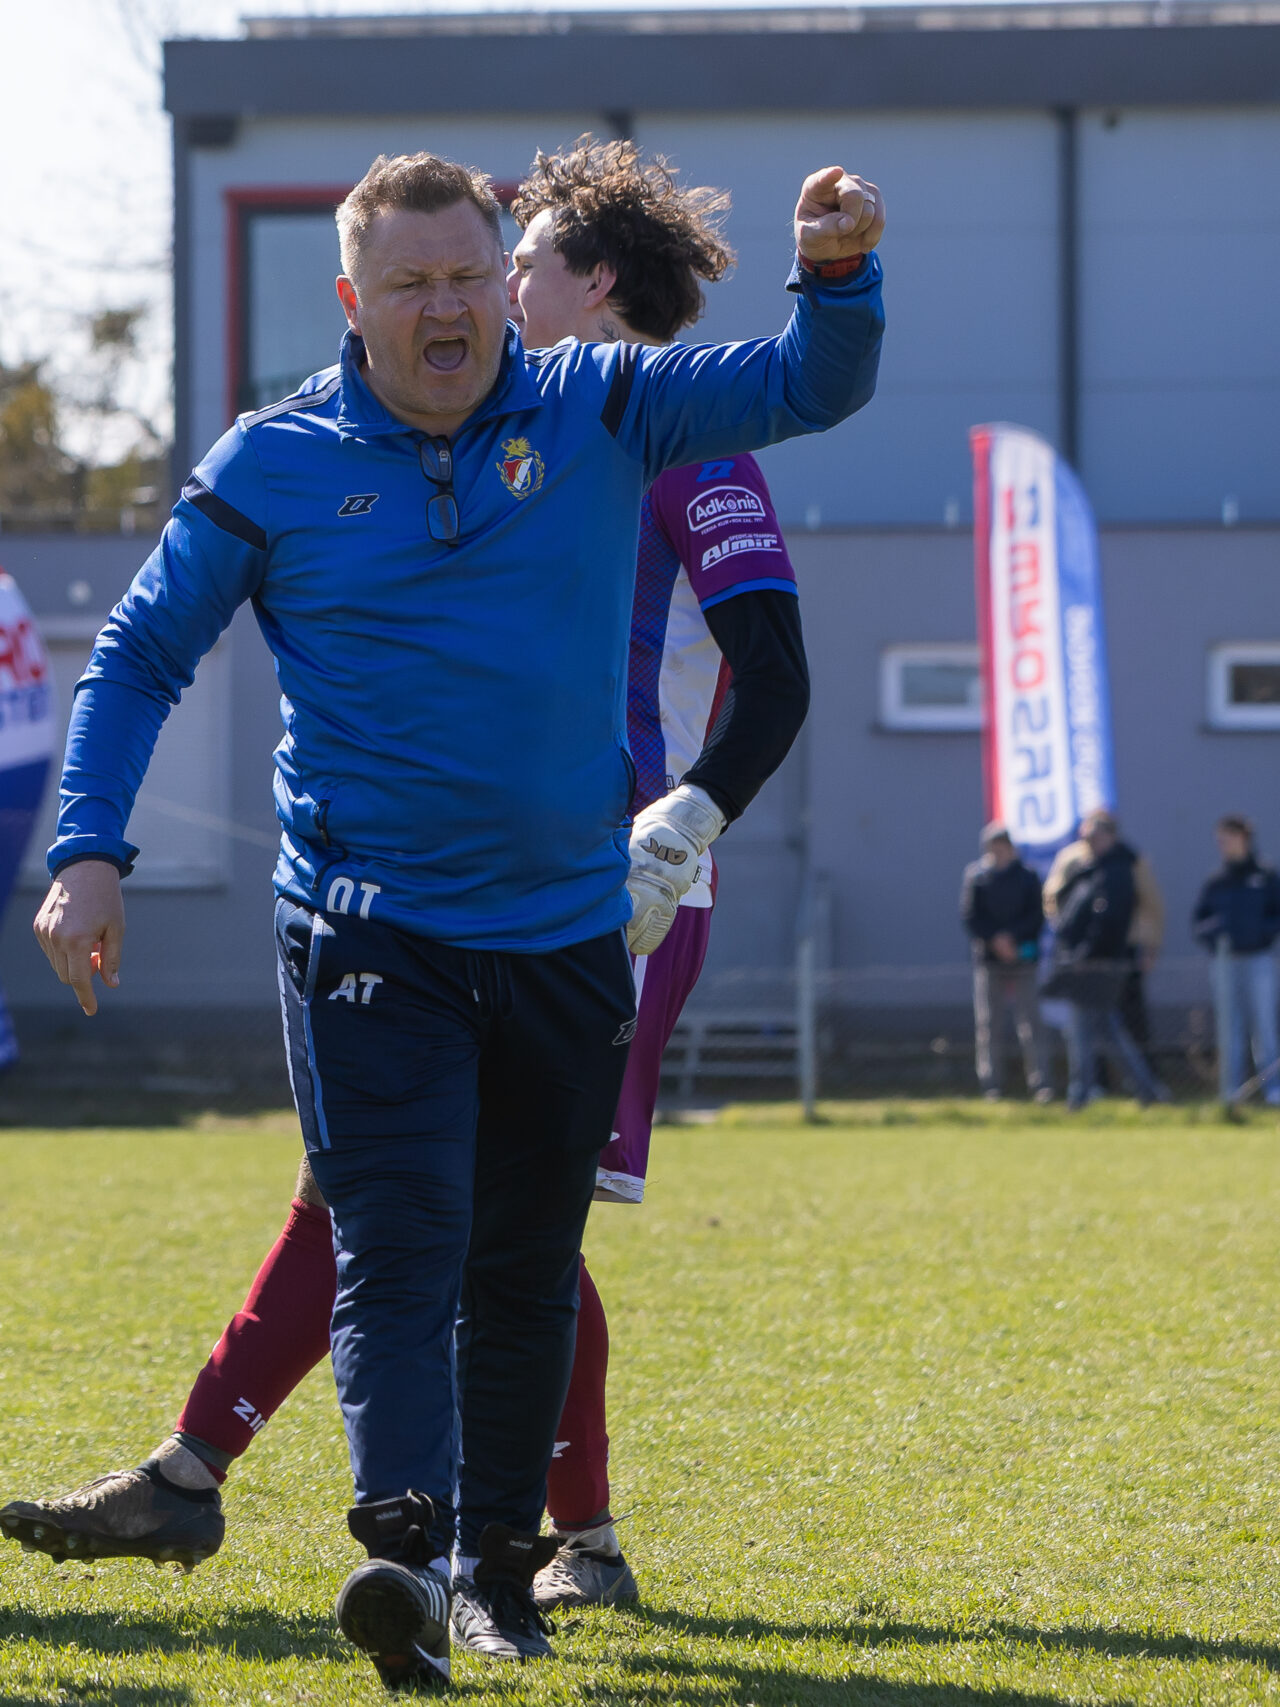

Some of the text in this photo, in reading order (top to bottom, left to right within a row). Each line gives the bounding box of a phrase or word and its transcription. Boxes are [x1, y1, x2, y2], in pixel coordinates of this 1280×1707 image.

[696, 493, 758, 521] Adkonis
[702, 539, 778, 567] Almir
[328, 973, 383, 1004] AT
